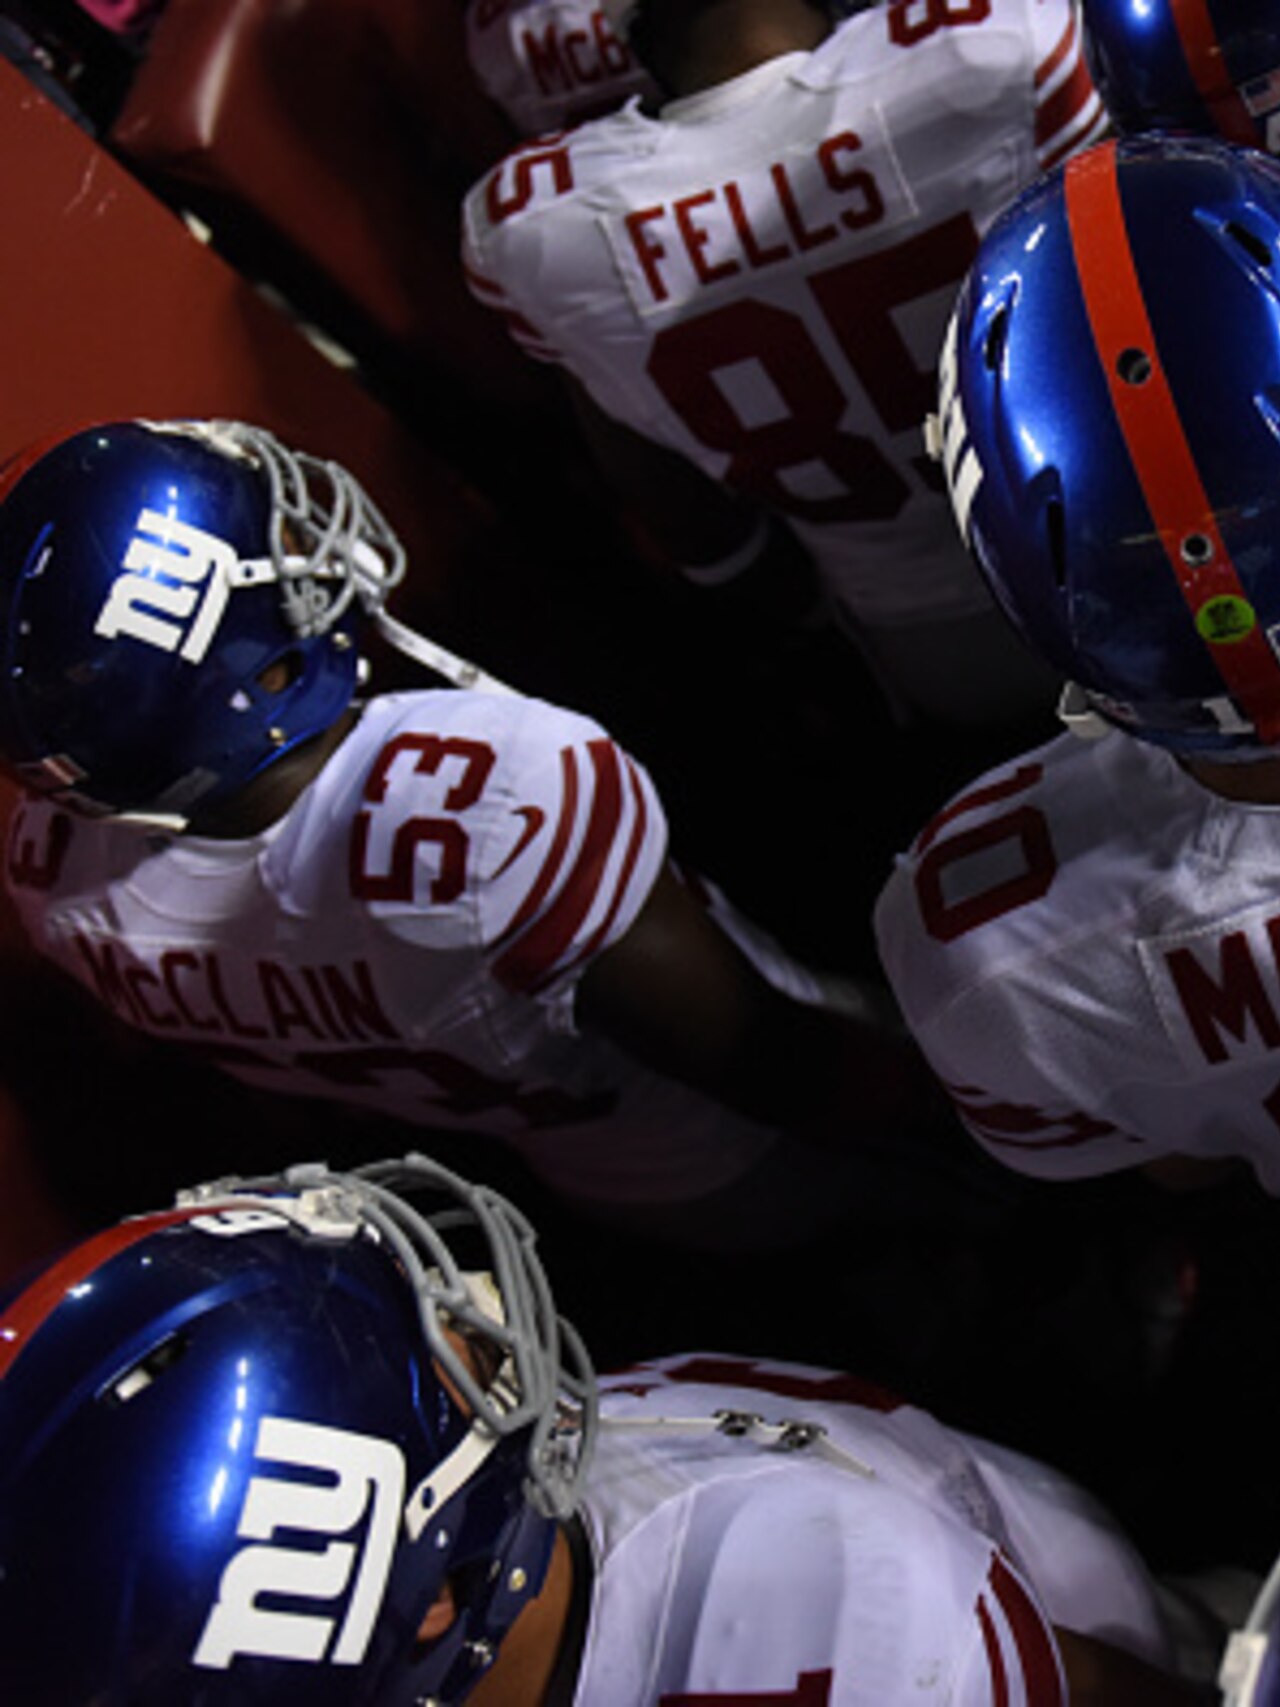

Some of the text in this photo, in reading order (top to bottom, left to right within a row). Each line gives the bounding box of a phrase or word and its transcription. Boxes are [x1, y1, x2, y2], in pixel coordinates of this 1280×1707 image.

[626, 133, 885, 301] FELLS
[349, 731, 497, 902] 53
[74, 934, 402, 1043] McCLAIN
